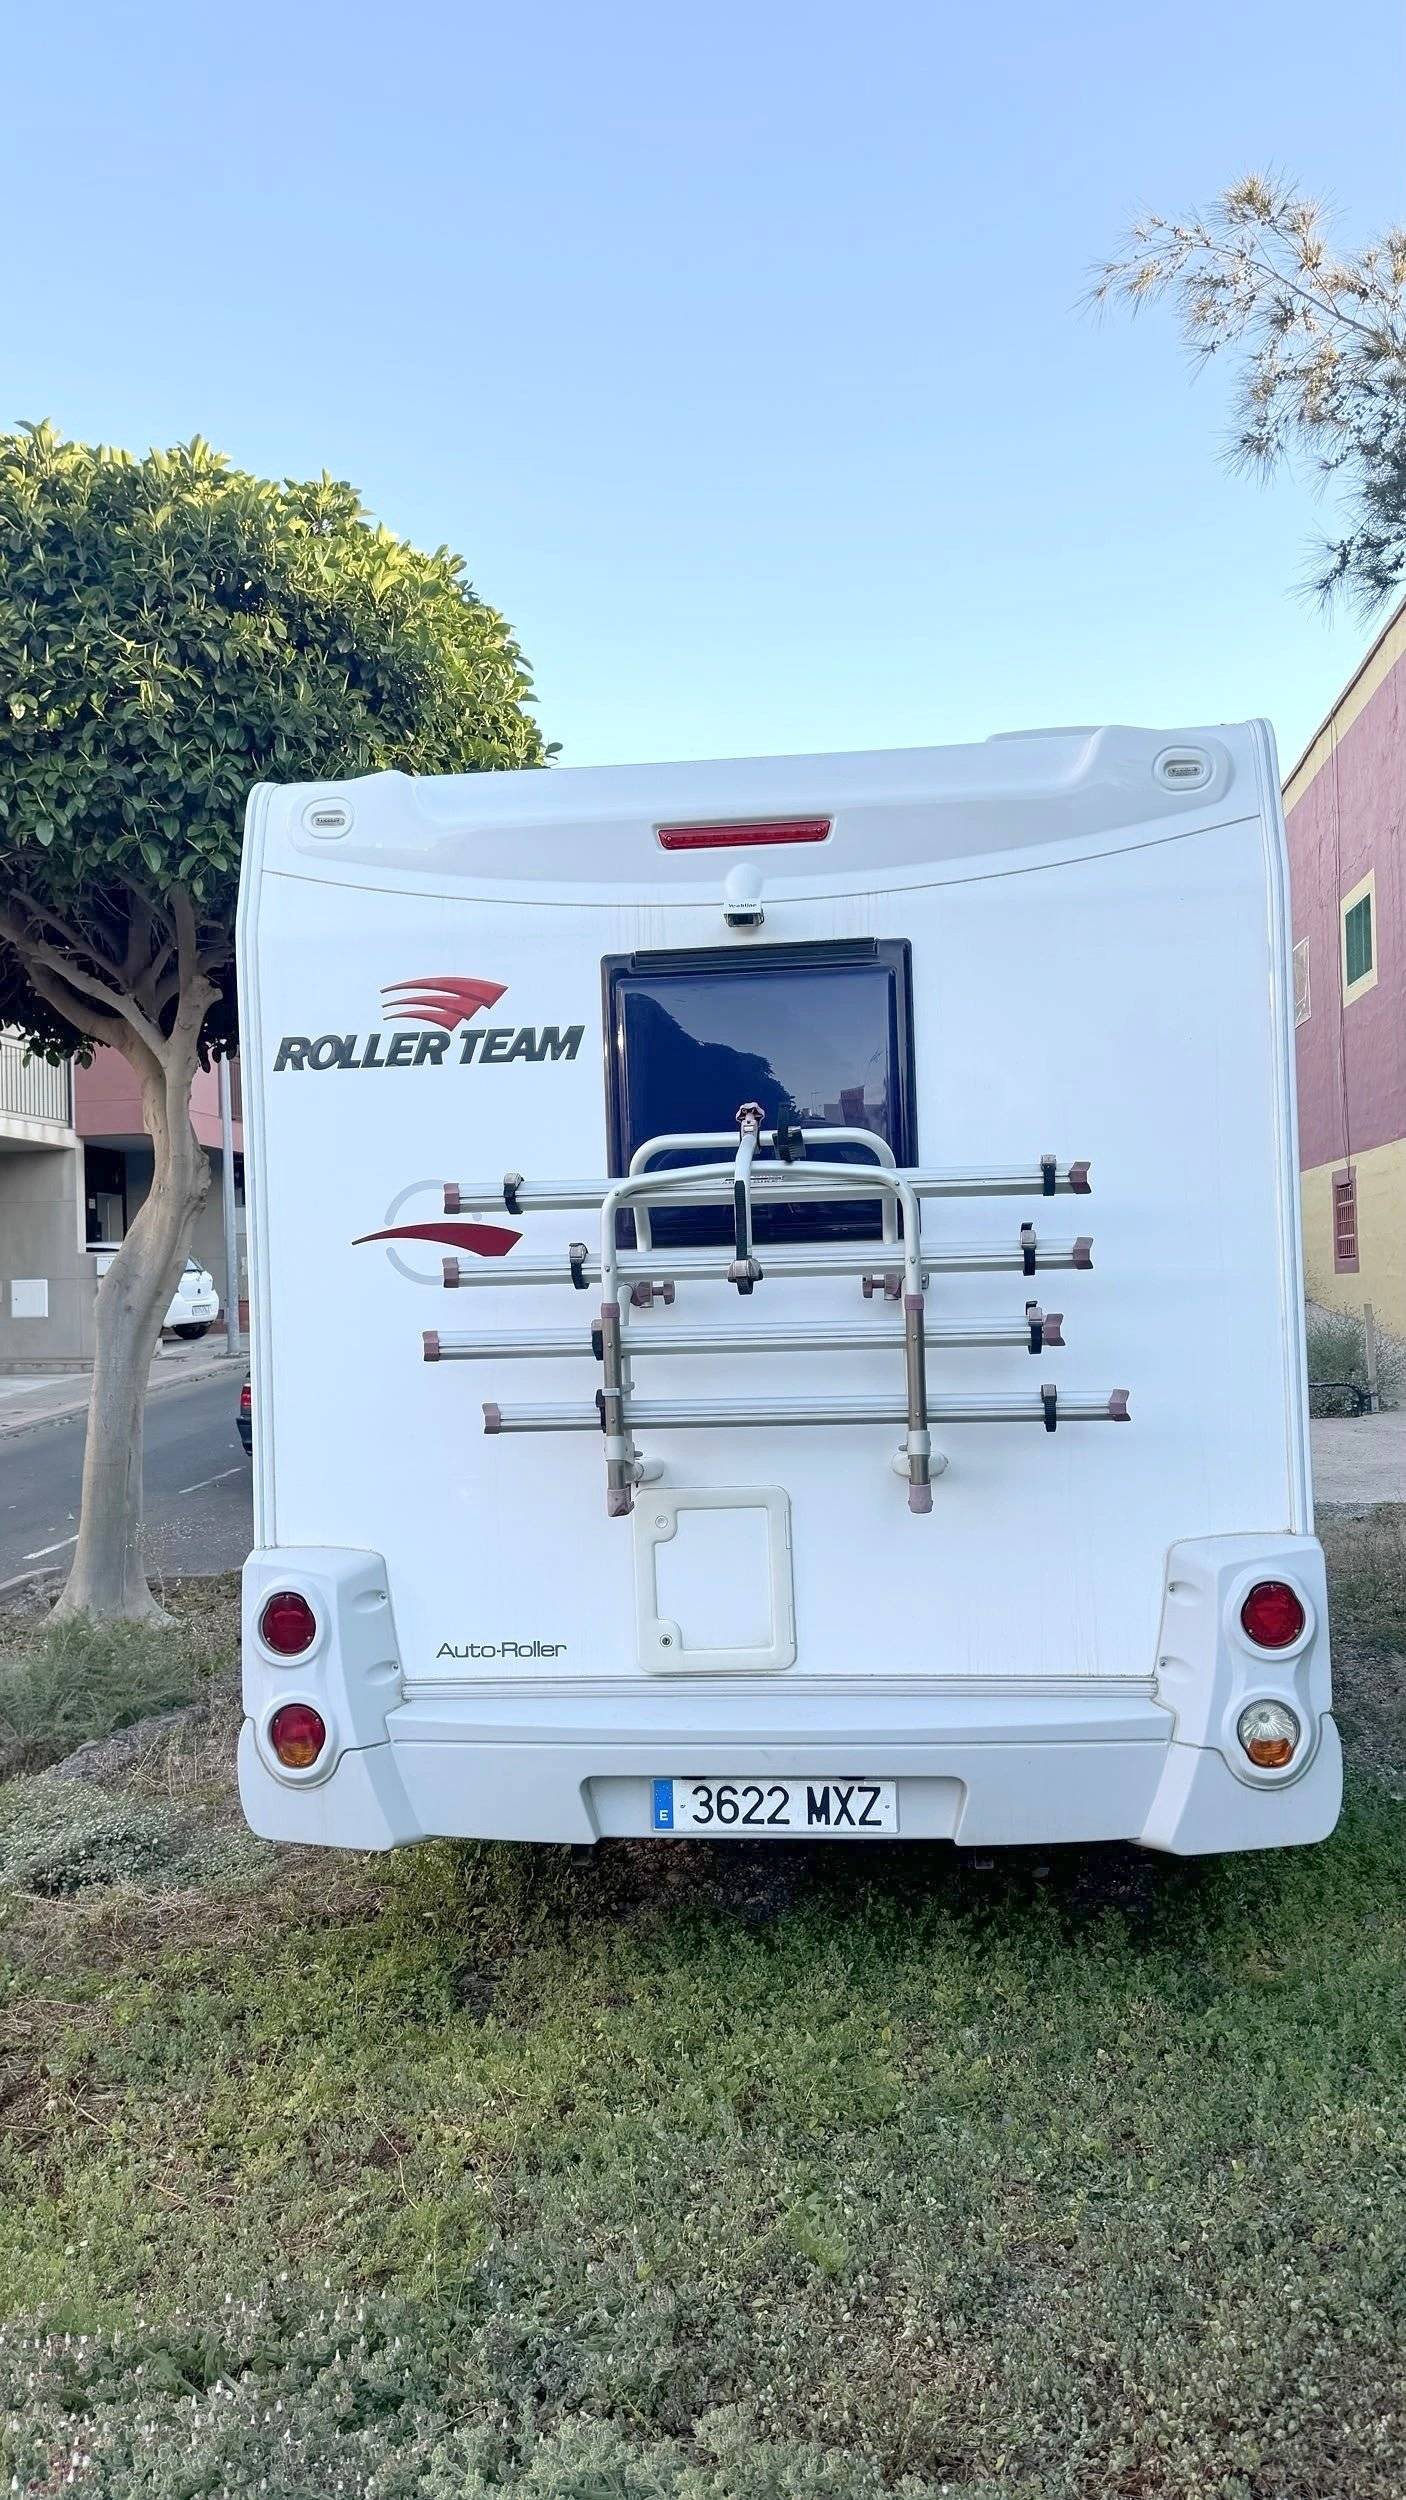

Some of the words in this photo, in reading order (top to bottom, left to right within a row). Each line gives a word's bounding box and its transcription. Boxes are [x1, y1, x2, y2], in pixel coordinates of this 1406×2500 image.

[273, 1031, 451, 1071] ROLLER
[459, 1025, 586, 1064] TEAM
[436, 1641, 567, 1658] Auto-Roller
[659, 1810, 669, 1821] E
[692, 1785, 790, 1825] 3622
[806, 1786, 882, 1826] MXZ
